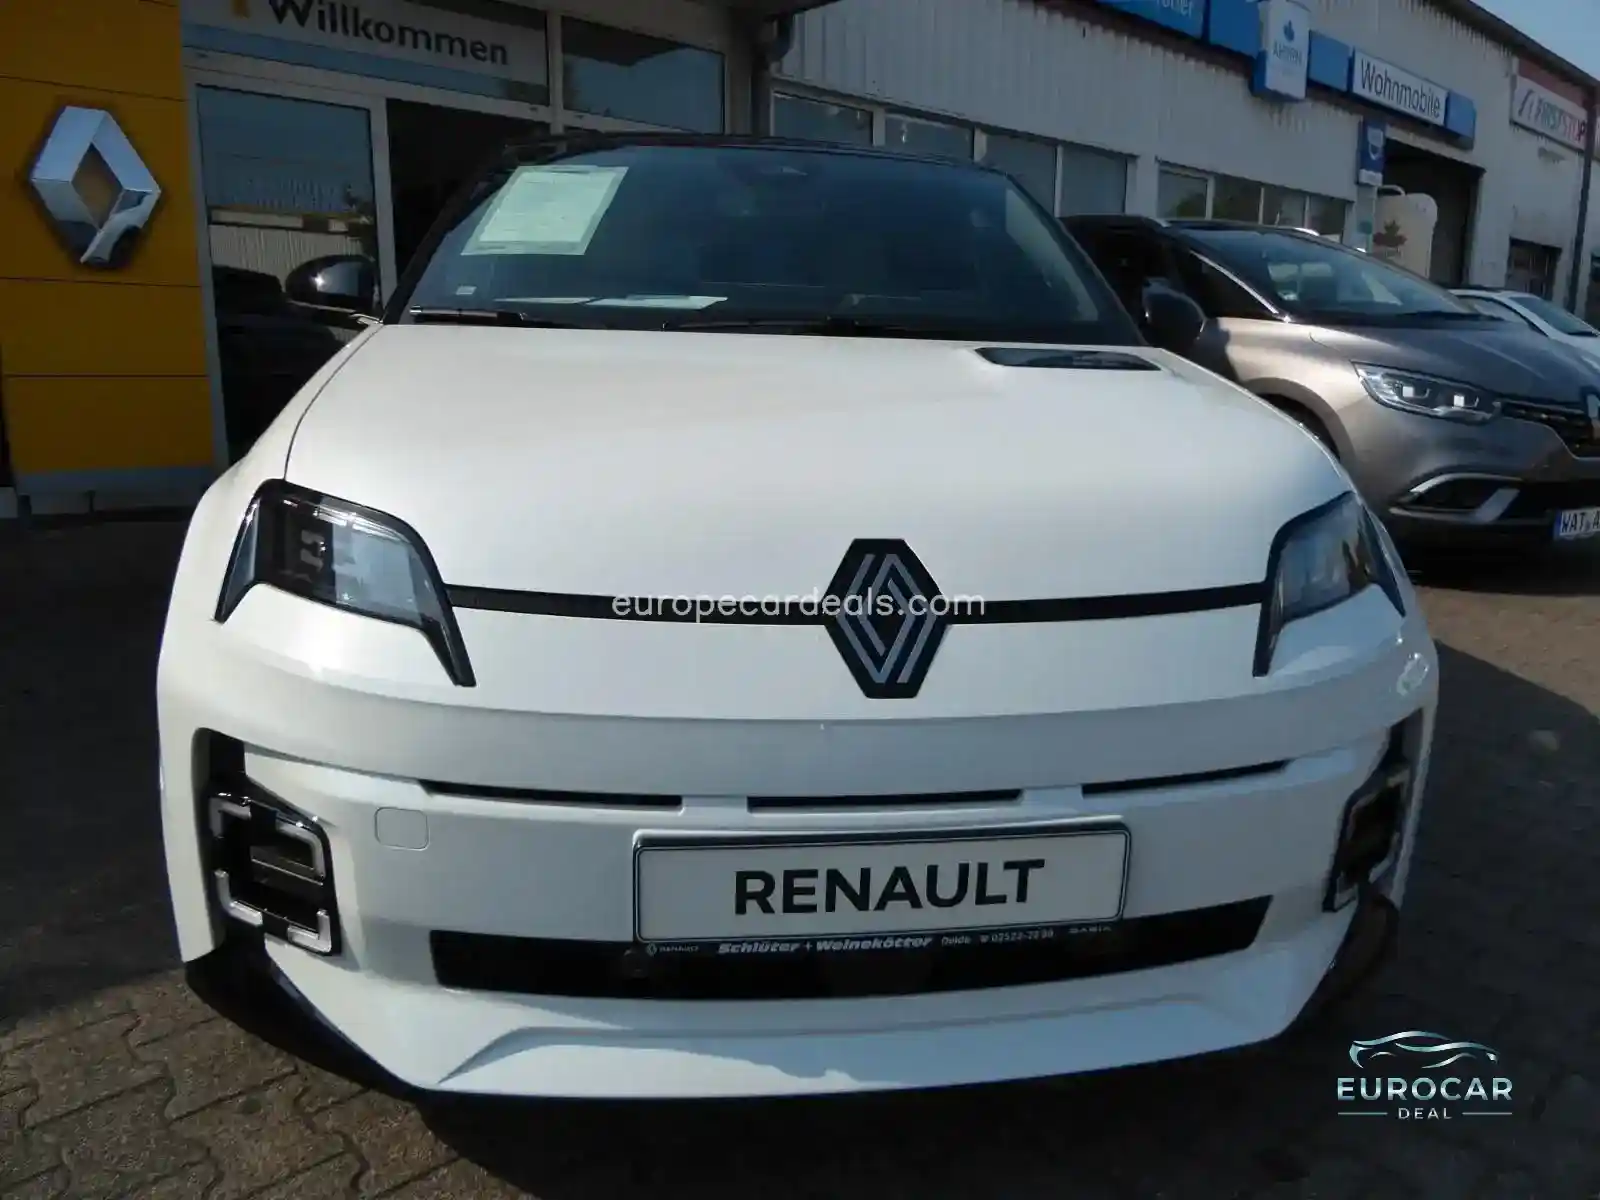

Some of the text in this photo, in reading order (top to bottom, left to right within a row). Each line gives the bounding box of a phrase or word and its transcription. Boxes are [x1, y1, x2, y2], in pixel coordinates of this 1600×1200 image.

[269, 0, 508, 65] Willkommen
[1361, 58, 1440, 118] Wohnmobile
[1562, 512, 1586, 533] WAT
[734, 858, 1045, 916] RENAULT
[717, 940, 801, 955] Schlüter
